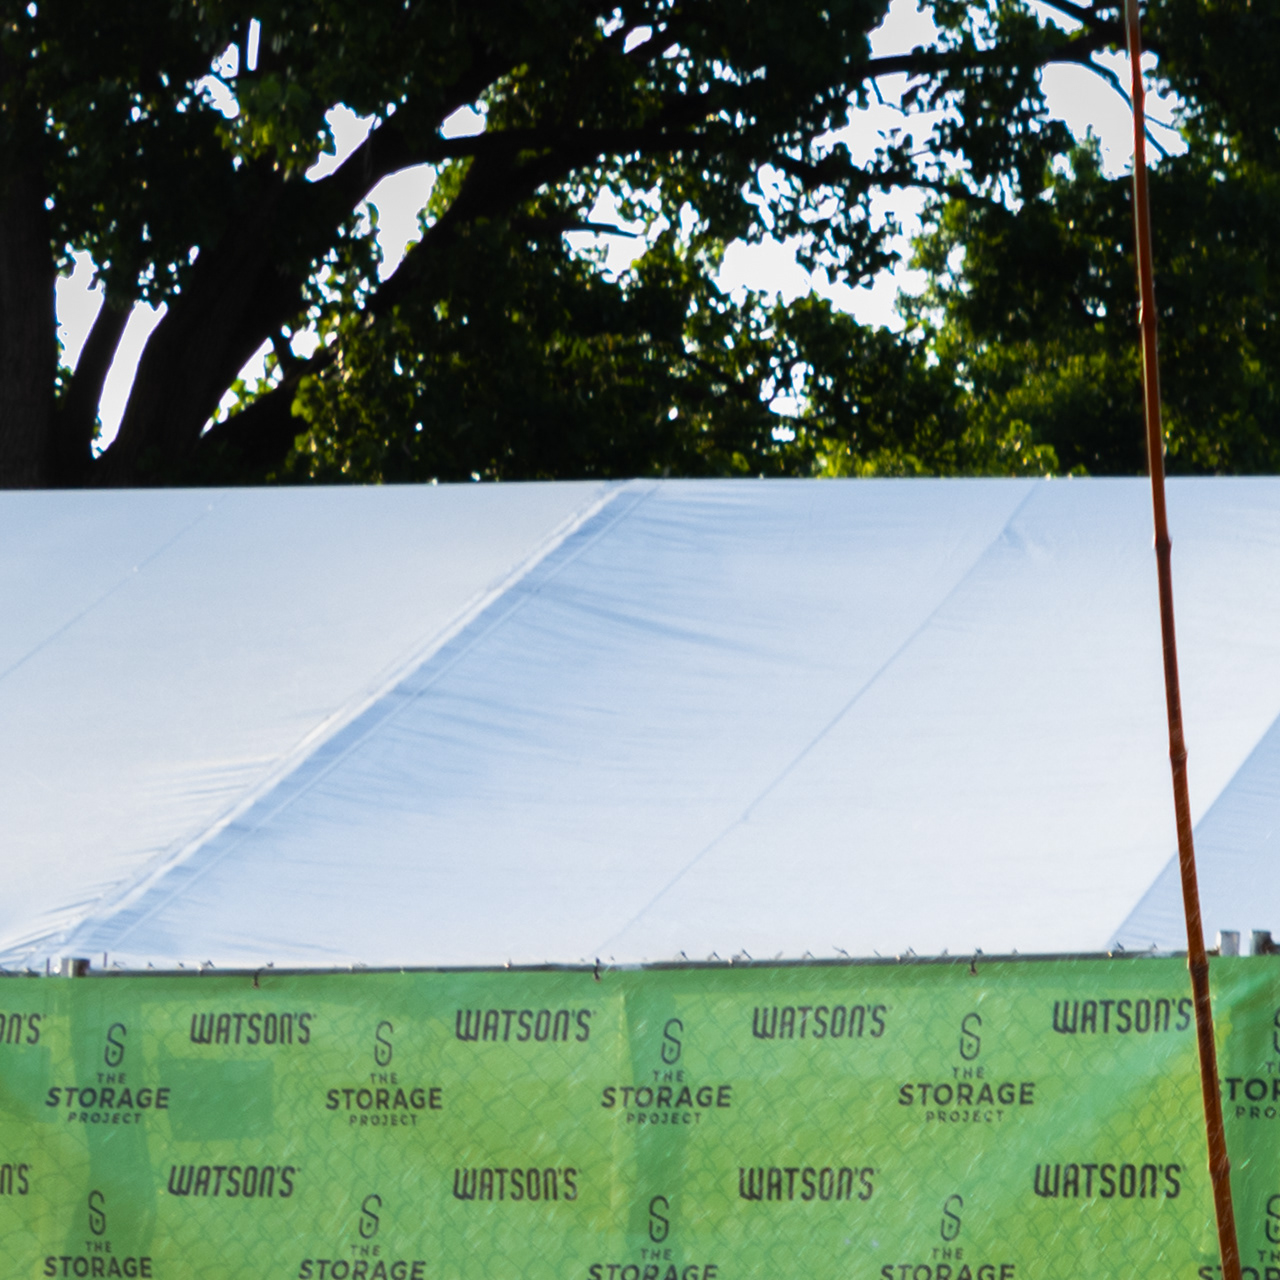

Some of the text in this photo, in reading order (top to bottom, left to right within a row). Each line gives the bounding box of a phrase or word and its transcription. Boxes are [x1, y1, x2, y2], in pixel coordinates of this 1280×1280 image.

[456, 1009, 591, 1042] WATSON'S
[753, 1006, 887, 1039] WATSON'S
[1053, 999, 1192, 1034] WATSON'S
[190, 1013, 311, 1045] WATSON'S
[97, 1073, 126, 1084] THE
[370, 1073, 397, 1084] THE
[653, 1071, 684, 1083] THE
[953, 1067, 984, 1079] THE
[45, 1087, 171, 1109] STORAGE
[325, 1088, 442, 1111] STORAGE
[602, 1085, 732, 1108] STORAGE
[899, 1083, 1035, 1106] STORAGE
[68, 1113, 142, 1124] PROJECT
[349, 1114, 418, 1126] PROJECT
[627, 1112, 702, 1124] PROJECT
[926, 1110, 1004, 1122] PROJECT
[168, 1165, 295, 1197] WATSON'S
[453, 1167, 578, 1201] WATSON'S
[739, 1167, 873, 1201] WATSON'S
[1034, 1164, 1181, 1199] WATSON'S
[86, 1241, 111, 1253] THE
[351, 1245, 380, 1256] THE
[642, 1249, 672, 1260] THE
[932, 1248, 963, 1260] THE
[44, 1256, 152, 1279] STORAGE
